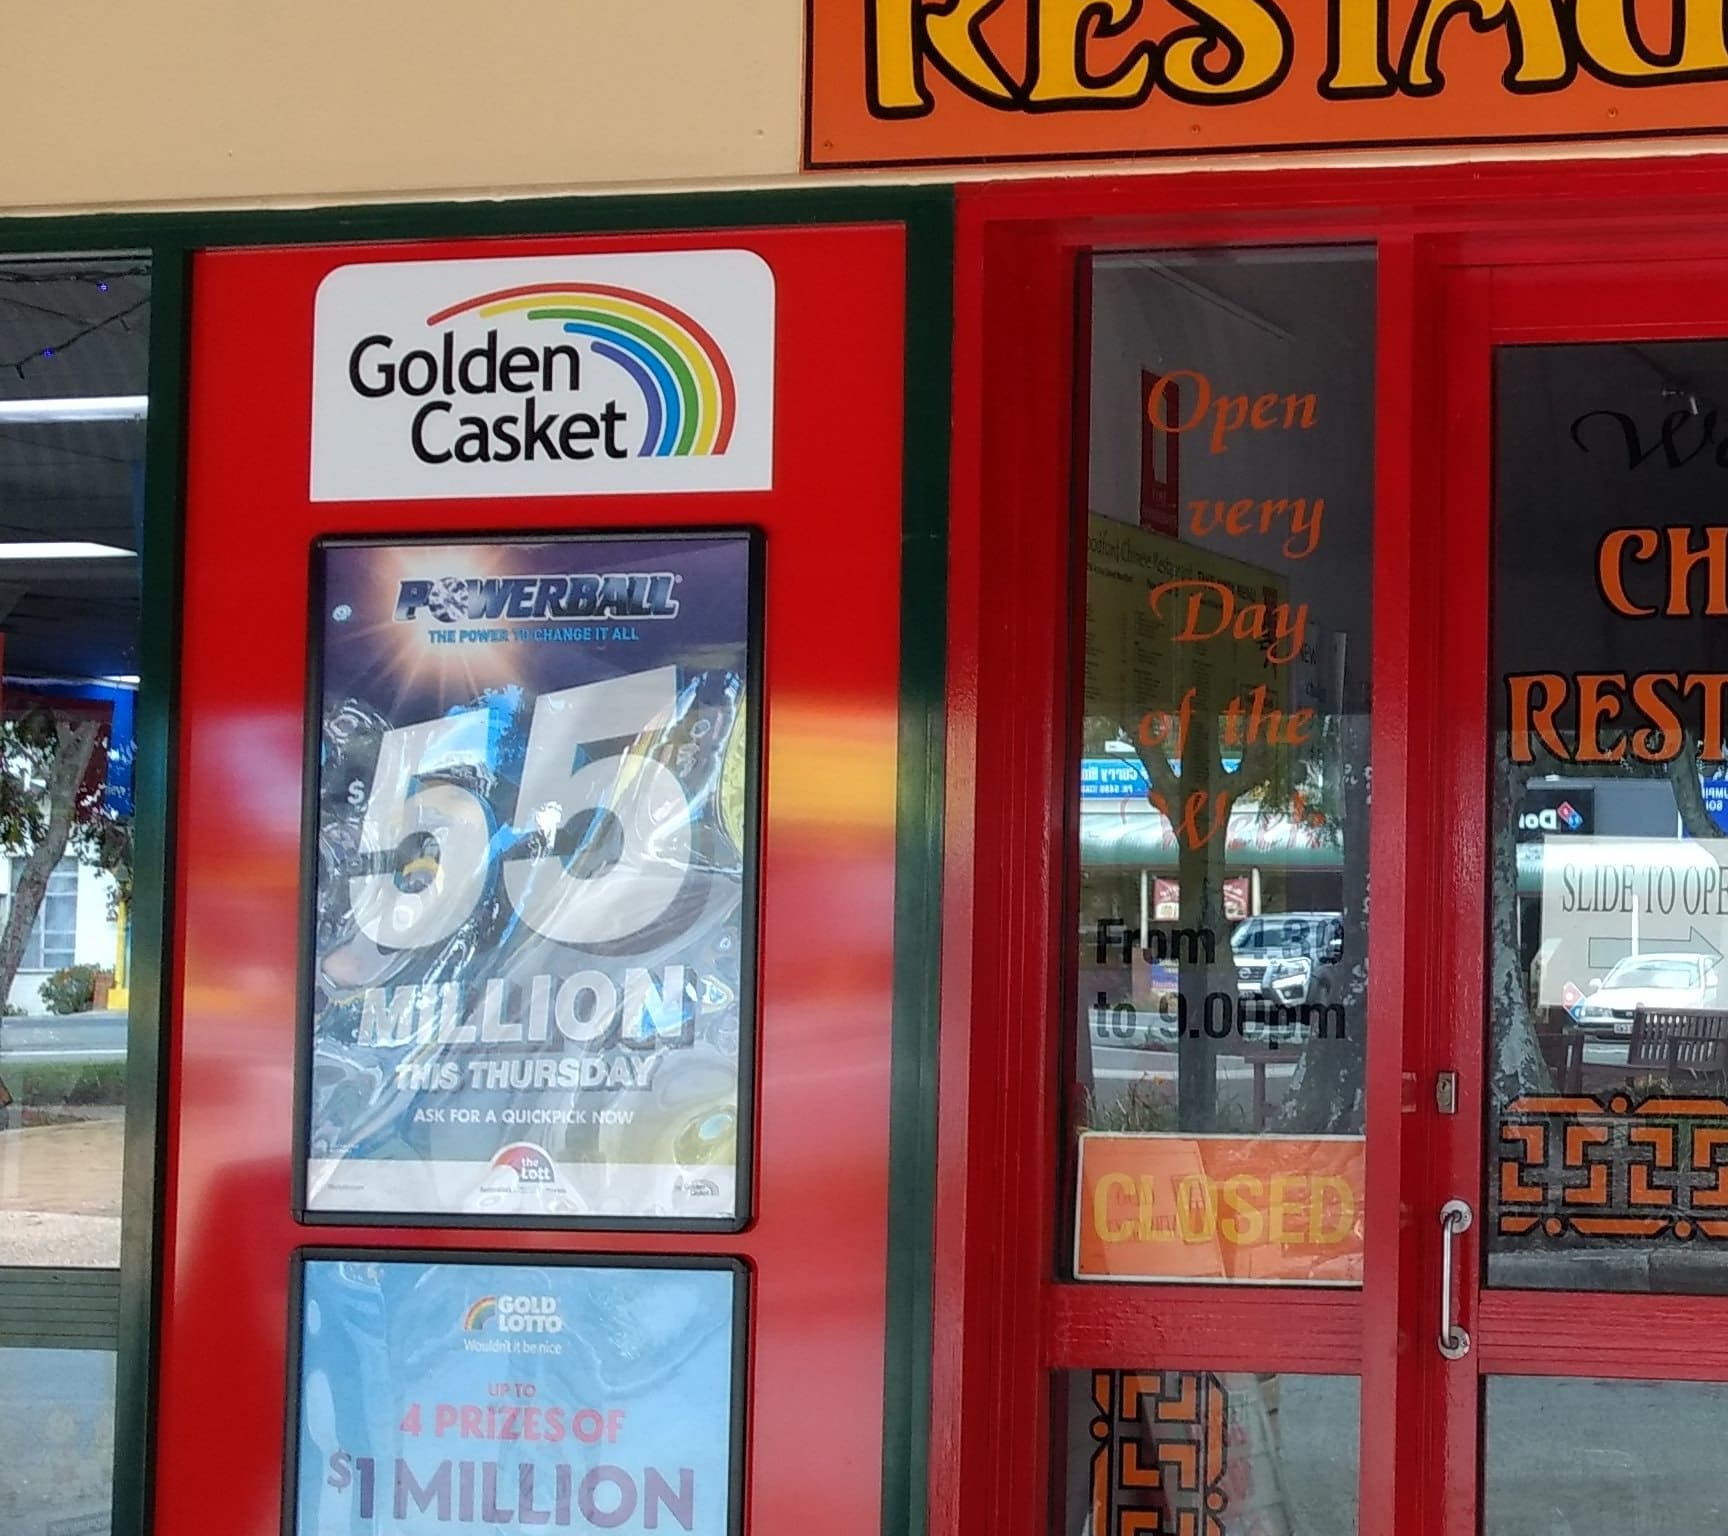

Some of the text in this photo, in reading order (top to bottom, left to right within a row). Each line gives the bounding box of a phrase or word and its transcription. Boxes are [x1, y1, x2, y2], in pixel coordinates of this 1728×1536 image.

[349, 330, 580, 398] Golden
[411, 397, 628, 464] Casket
[1147, 370, 1318, 454] Open
[393, 573, 680, 622] POWERBALL
[1149, 579, 1309, 664] Day
[428, 627, 639, 644] THE POWER TO CHANGE IT ALL
[1138, 684, 1313, 760] of the
[1561, 863, 1634, 914] SLIDE
[1644, 866, 1677, 914] TO
[1095, 919, 1216, 964] From
[357, 965, 688, 1048] MILLION
[1095, 992, 1136, 1040] to
[395, 1056, 657, 1092] THIS THURSDAY
[413, 1108, 634, 1126] ASK FOR A QUICKPICK NOW
[1094, 1172, 1353, 1245] CLOSED
[498, 1296, 557, 1314] GOLD
[499, 1314, 562, 1333] LOTTO
[488, 1383, 537, 1398] UP TO
[400, 1404, 626, 1444] 4 PRIZES OF
[393, 1457, 695, 1531] MILLION
